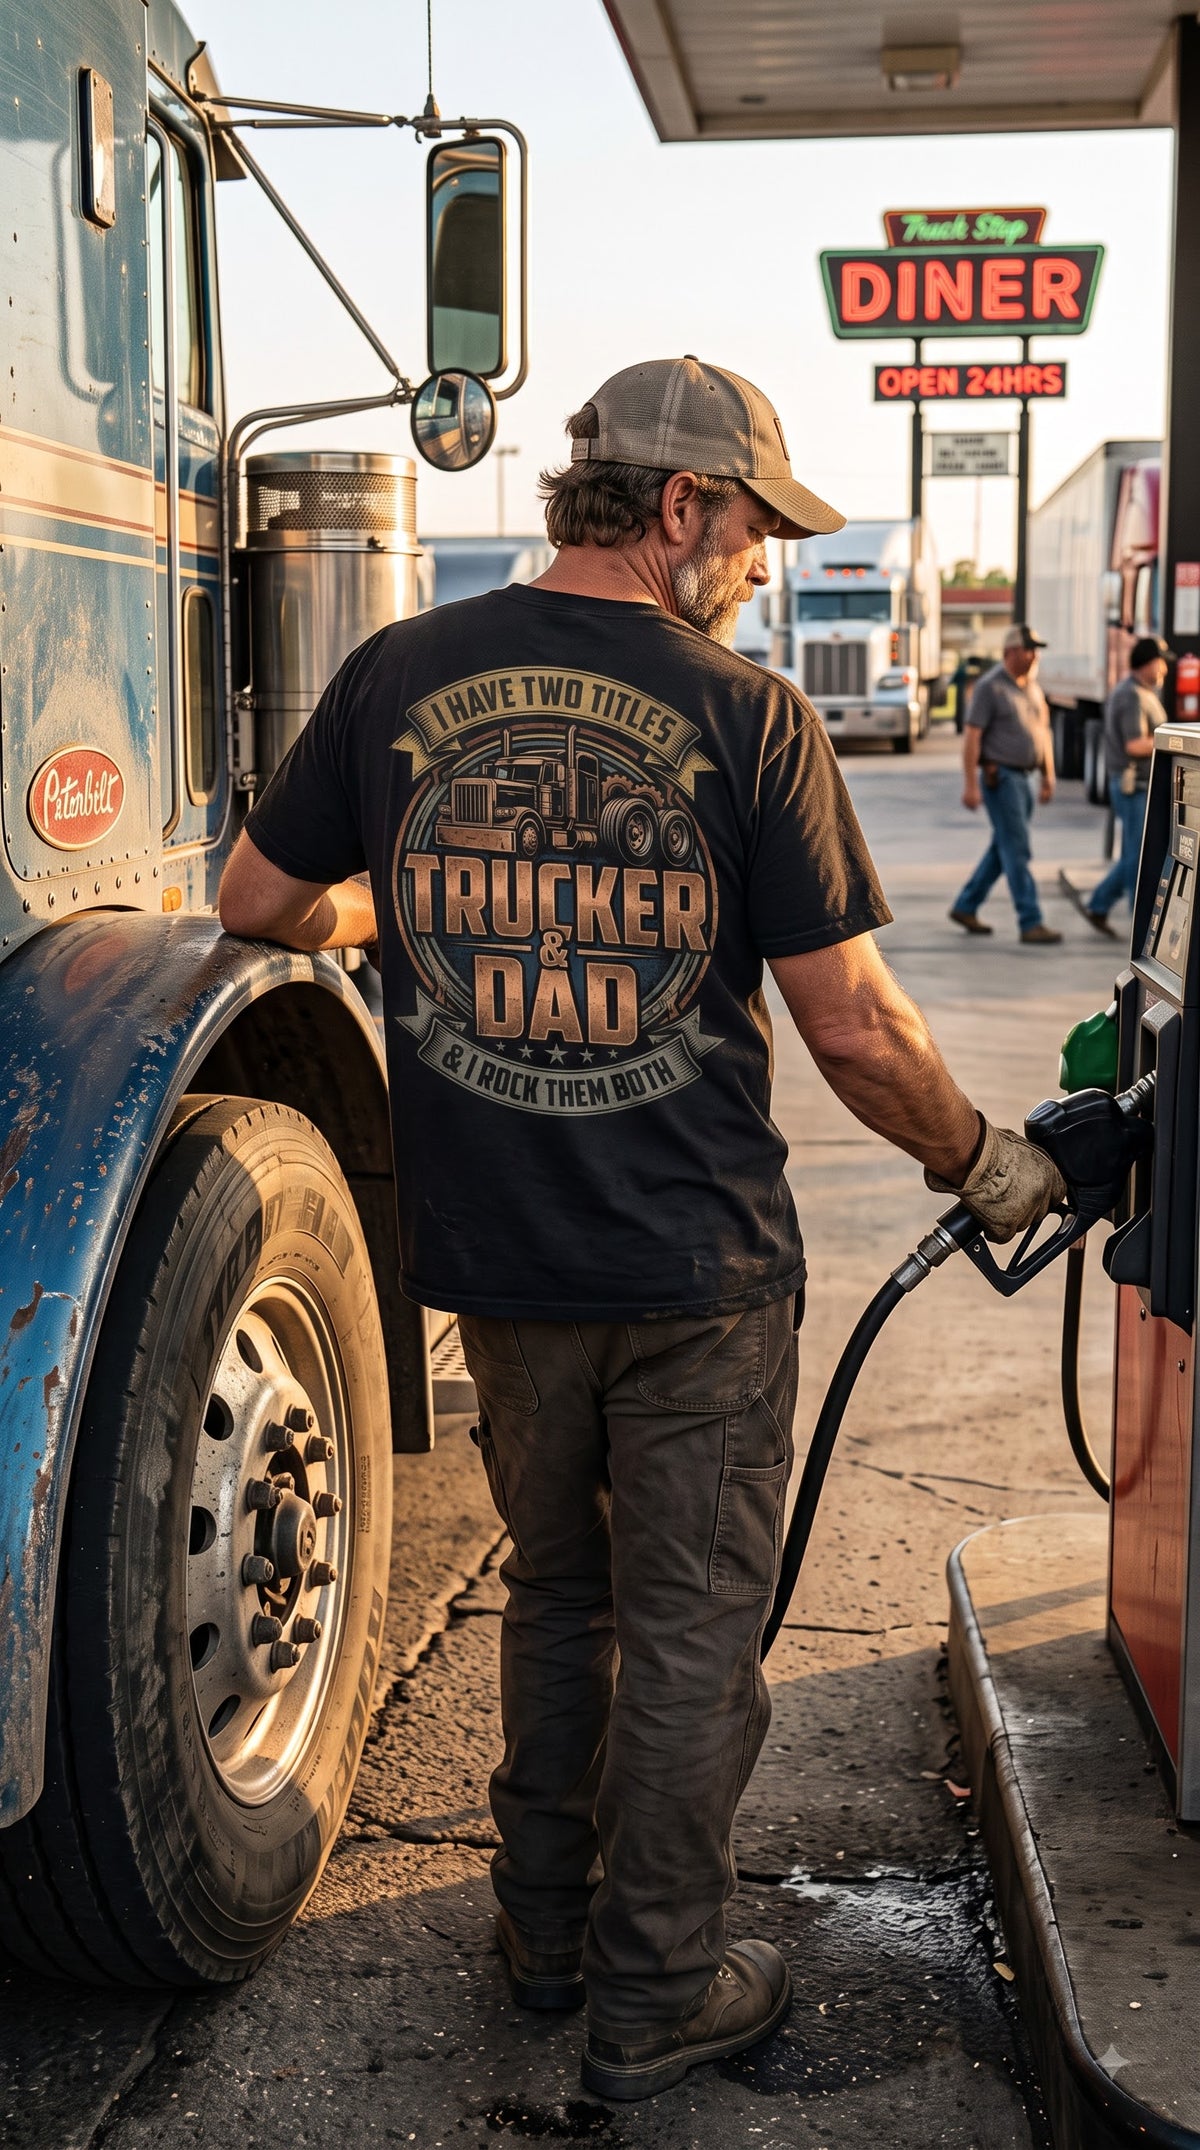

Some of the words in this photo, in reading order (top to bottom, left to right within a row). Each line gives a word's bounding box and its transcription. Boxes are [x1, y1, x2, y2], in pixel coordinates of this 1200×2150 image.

[901, 213, 969, 243] Truck
[971, 212, 1029, 247] Stop
[840, 257, 1082, 323] DINER
[878, 366, 959, 397] OPEN
[965, 364, 1063, 396] 24HRS
[430, 702, 449, 732] I
[449, 677, 516, 726] HAVE
[521, 675, 584, 709] TWO
[591, 683, 678, 745] TITLES
[404, 853, 709, 951] TRUCKER
[539, 931, 569, 968] &
[474, 954, 638, 1047] DAD
[441, 1043, 467, 1074] &
[465, 1054, 477, 1080] I
[477, 1059, 538, 1105] ROCK
[545, 1076, 609, 1107] THEM
[611, 1056, 678, 1102] BOTH
